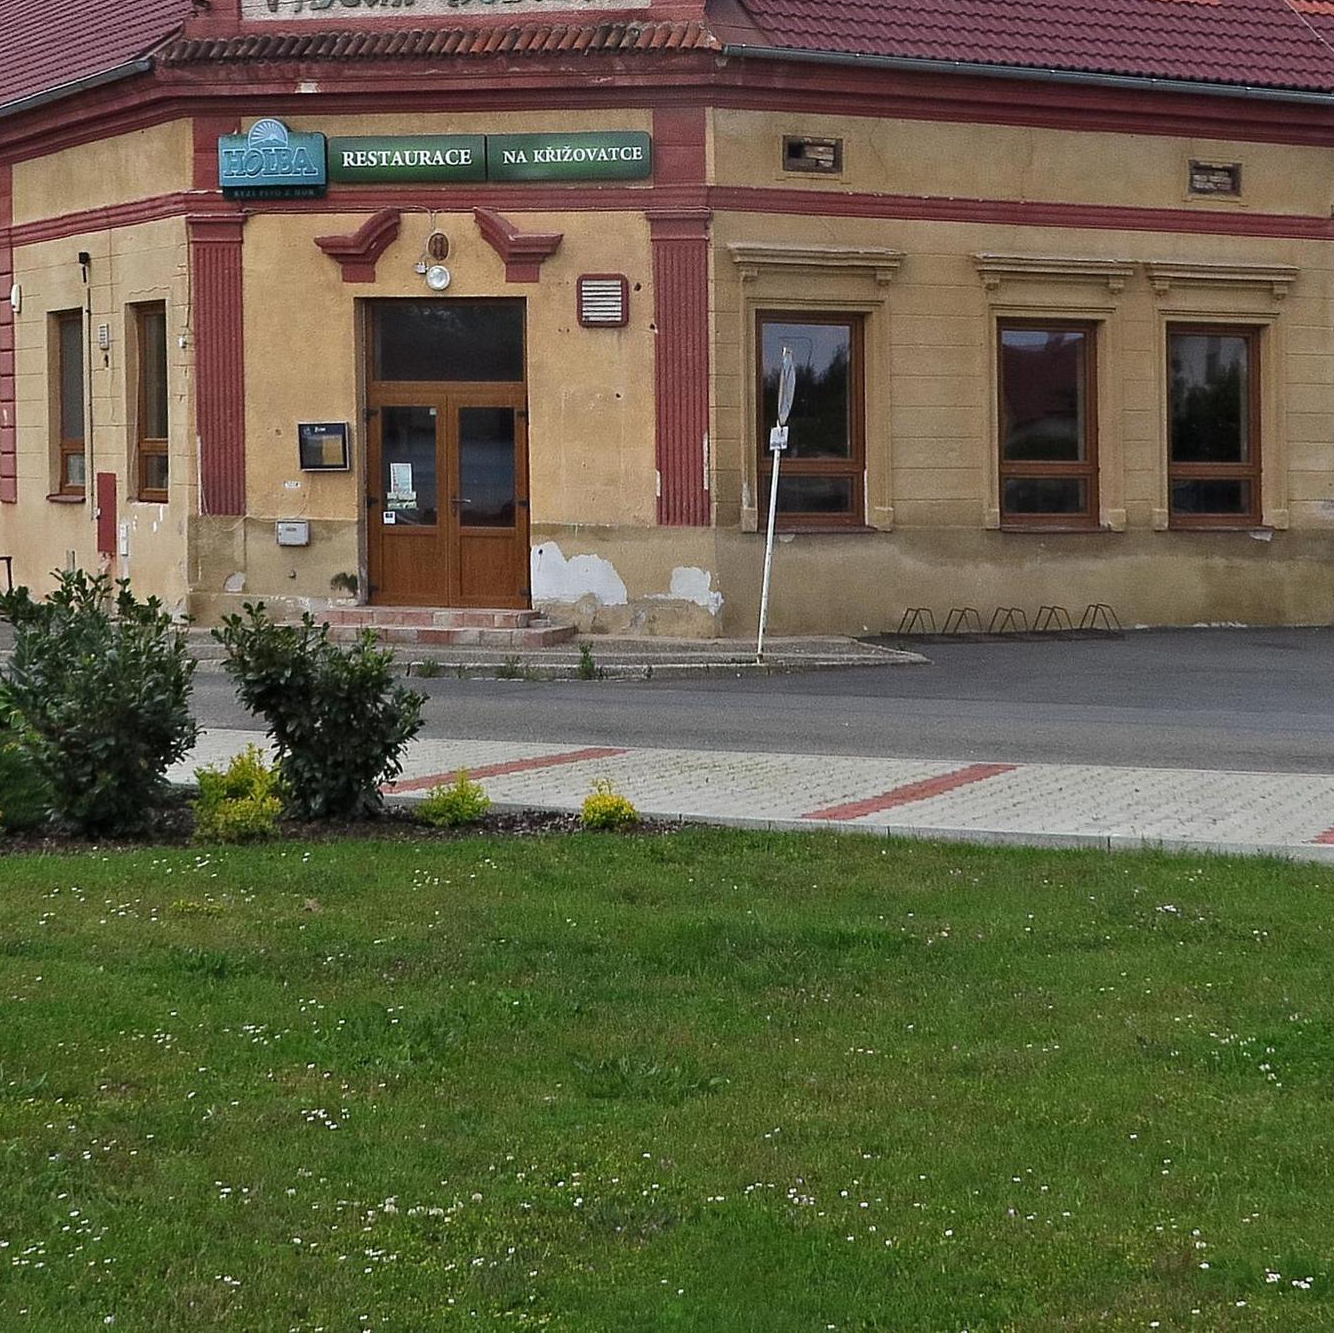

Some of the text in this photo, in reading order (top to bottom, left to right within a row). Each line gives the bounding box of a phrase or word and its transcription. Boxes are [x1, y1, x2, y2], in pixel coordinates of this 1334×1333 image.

[223, 147, 318, 177] HOLBA
[341, 149, 472, 167] RESTAURACE
[502, 145, 643, 164] NA KŘIŽOVATCE
